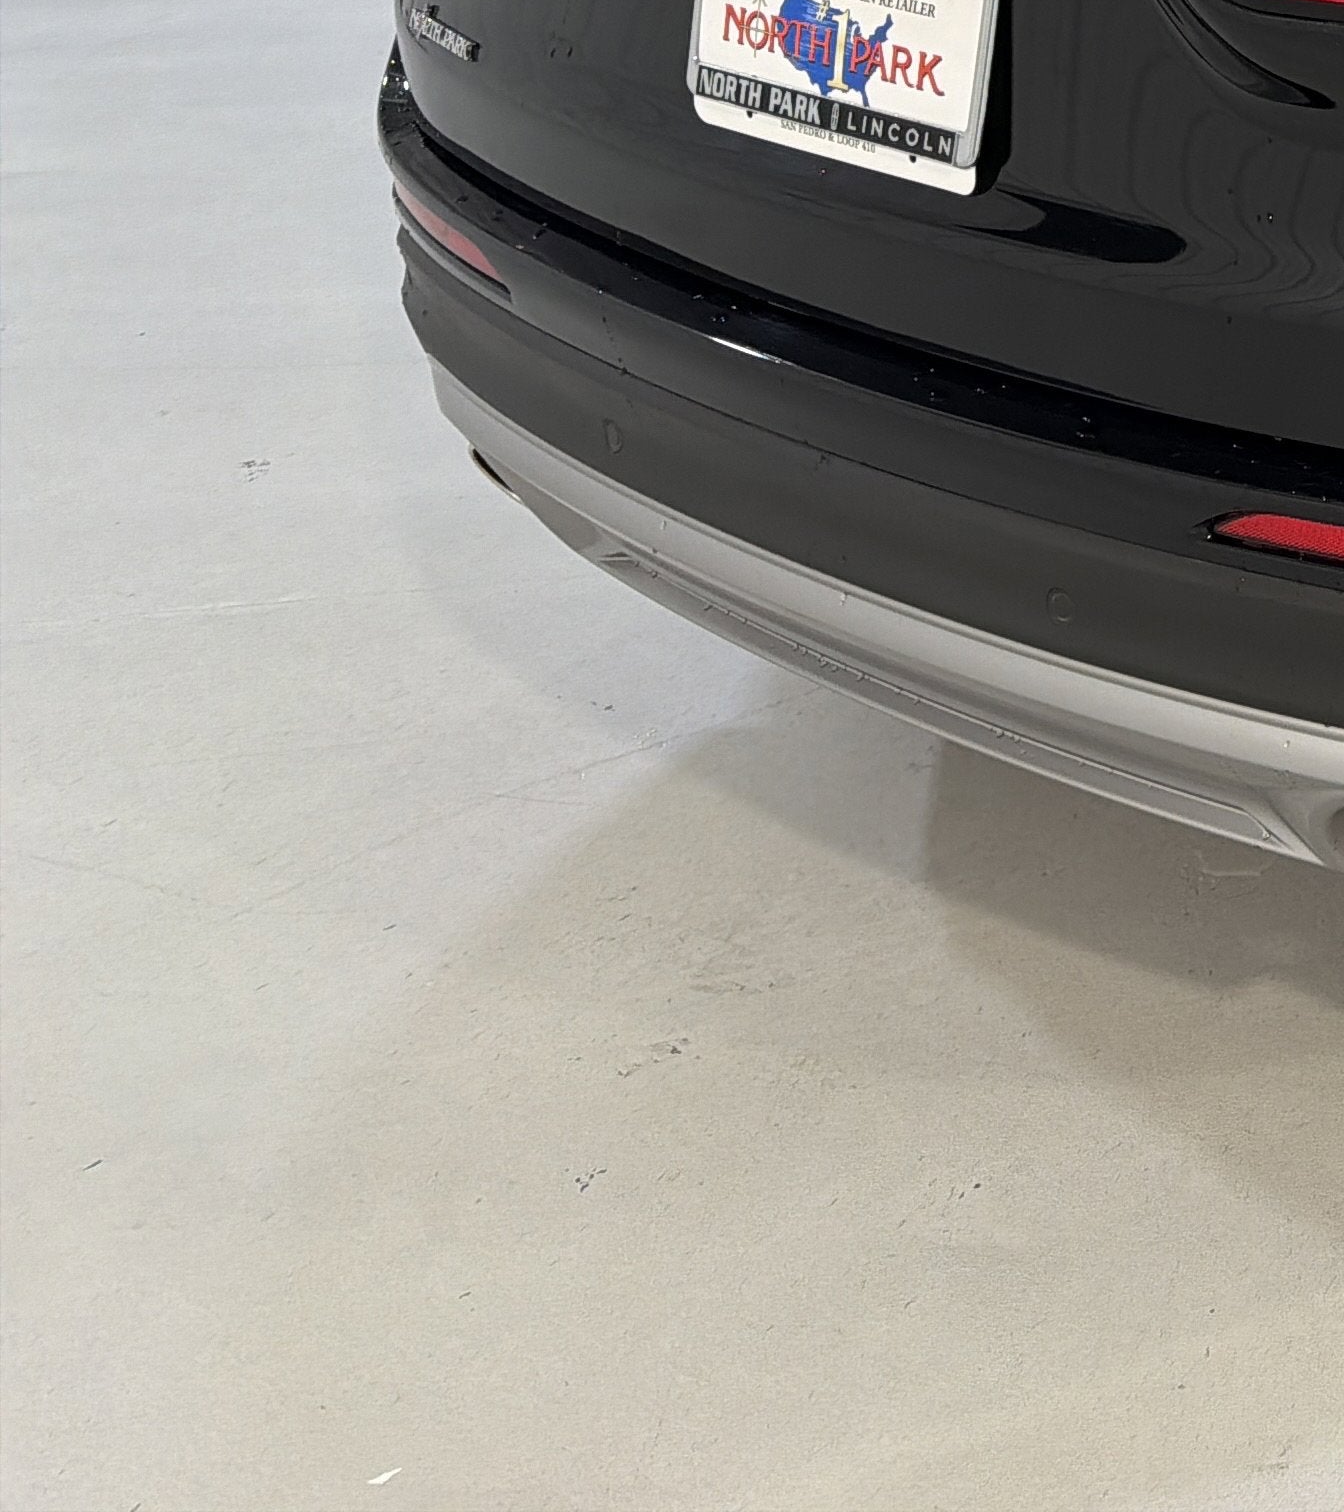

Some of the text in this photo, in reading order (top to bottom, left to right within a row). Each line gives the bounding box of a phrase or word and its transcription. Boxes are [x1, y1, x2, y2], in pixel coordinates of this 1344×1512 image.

[722, 3, 945, 96] NORTH PARK
[700, 68, 952, 157] NORTH PARK LINCOLN
[781, 119, 798, 132] SAN
